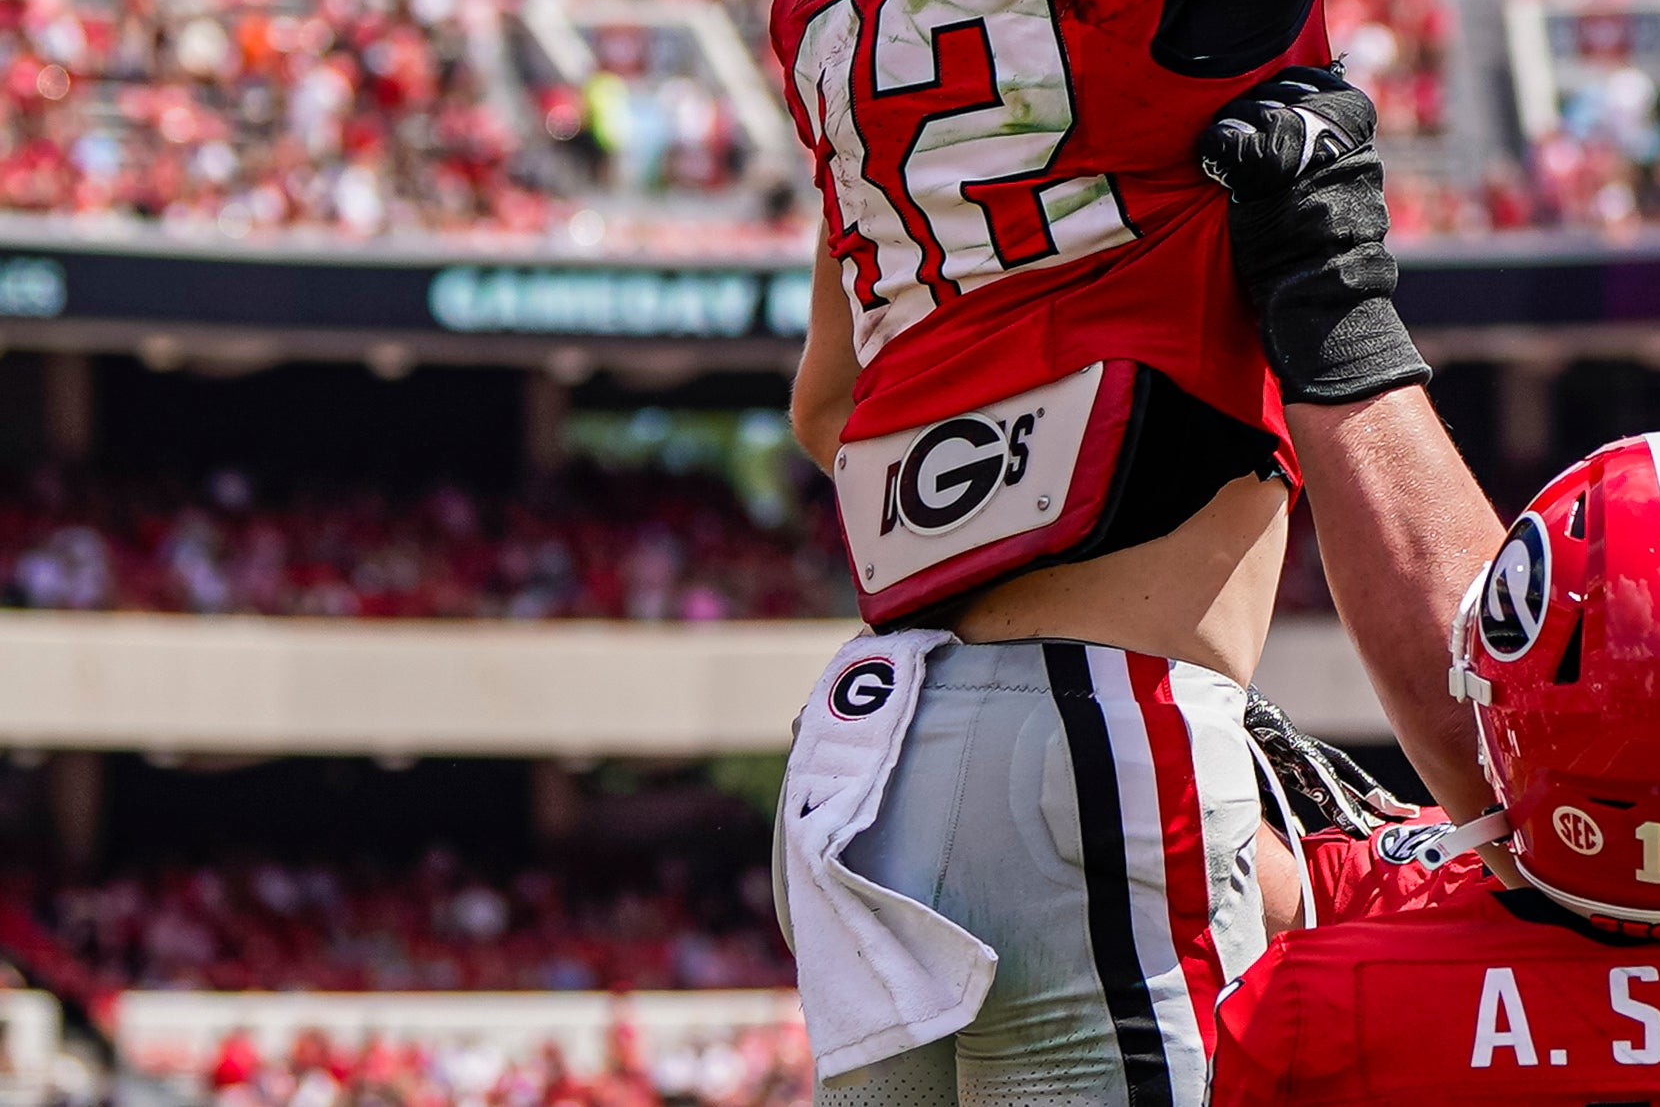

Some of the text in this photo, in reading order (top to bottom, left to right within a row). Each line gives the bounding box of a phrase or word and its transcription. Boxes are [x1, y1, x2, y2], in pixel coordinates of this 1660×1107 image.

[828, 657, 895, 721] G
[1556, 808, 1601, 853] SEC
[1470, 967, 1568, 1067] A.
